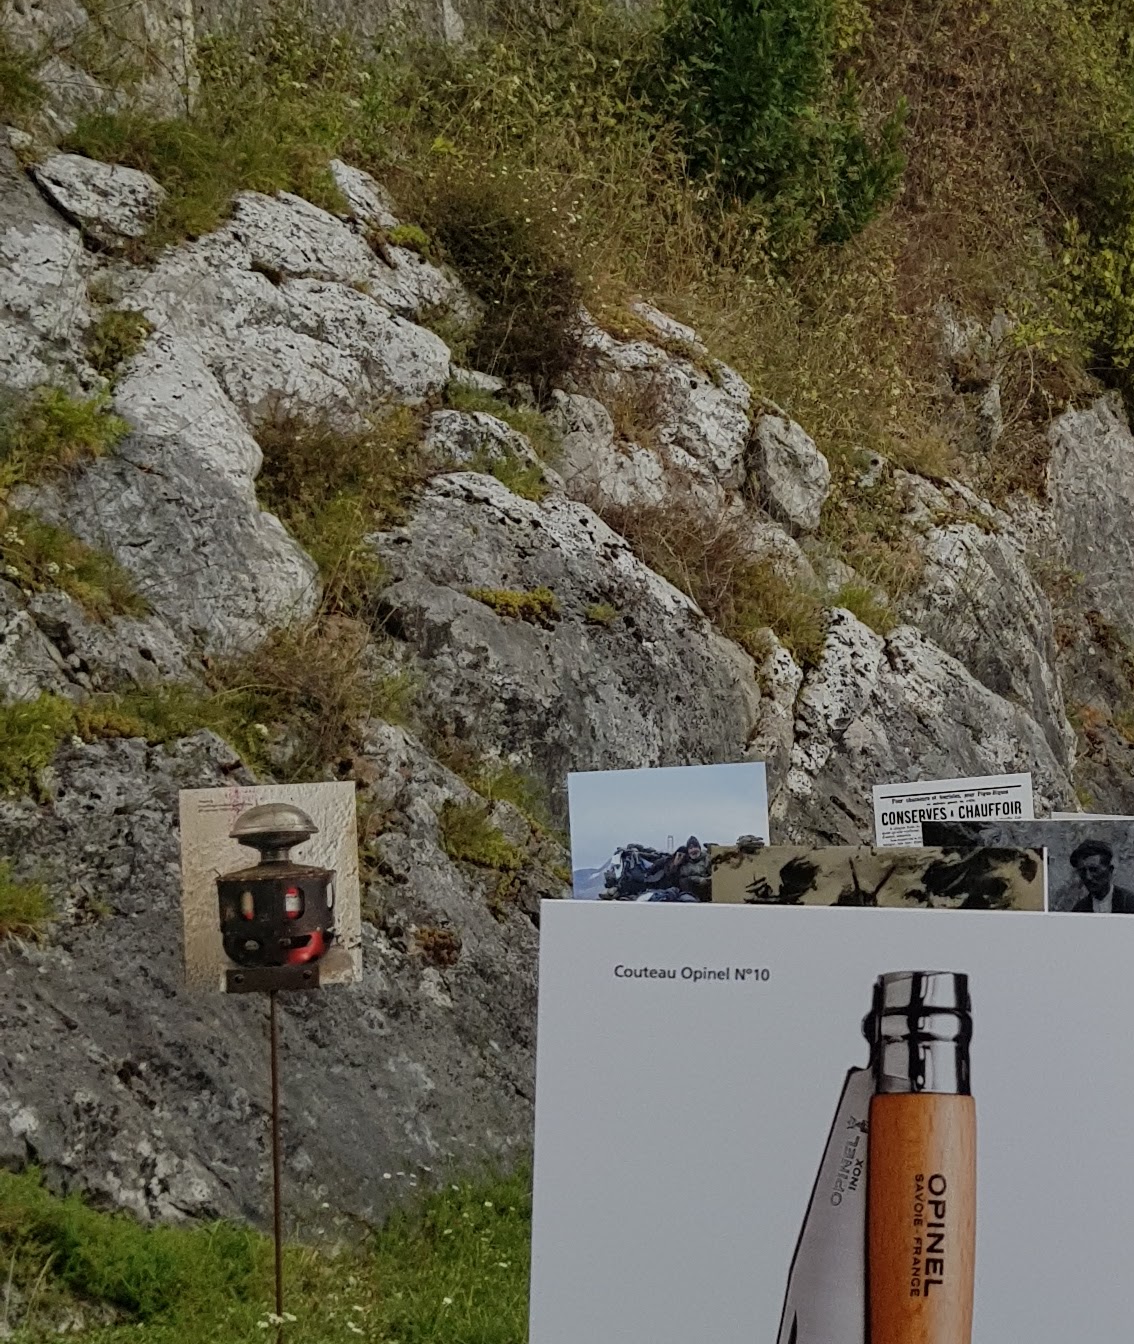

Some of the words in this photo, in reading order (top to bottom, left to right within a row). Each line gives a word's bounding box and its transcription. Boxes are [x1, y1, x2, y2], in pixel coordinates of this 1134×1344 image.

[881, 807, 947, 826] CONSERVES
[958, 800, 1022, 819] CHAUFFOIR
[614, 964, 676, 979] Couteau
[681, 966, 730, 982] Opinel
[735, 968, 770, 981] N°10
[830, 1135, 861, 1206] OPINEL
[848, 1158, 864, 1191] INOX
[913, 1173, 924, 1227] SAVOIE
[923, 1173, 947, 1297] OPINEL
[910, 1237, 923, 1297] FRANCE
